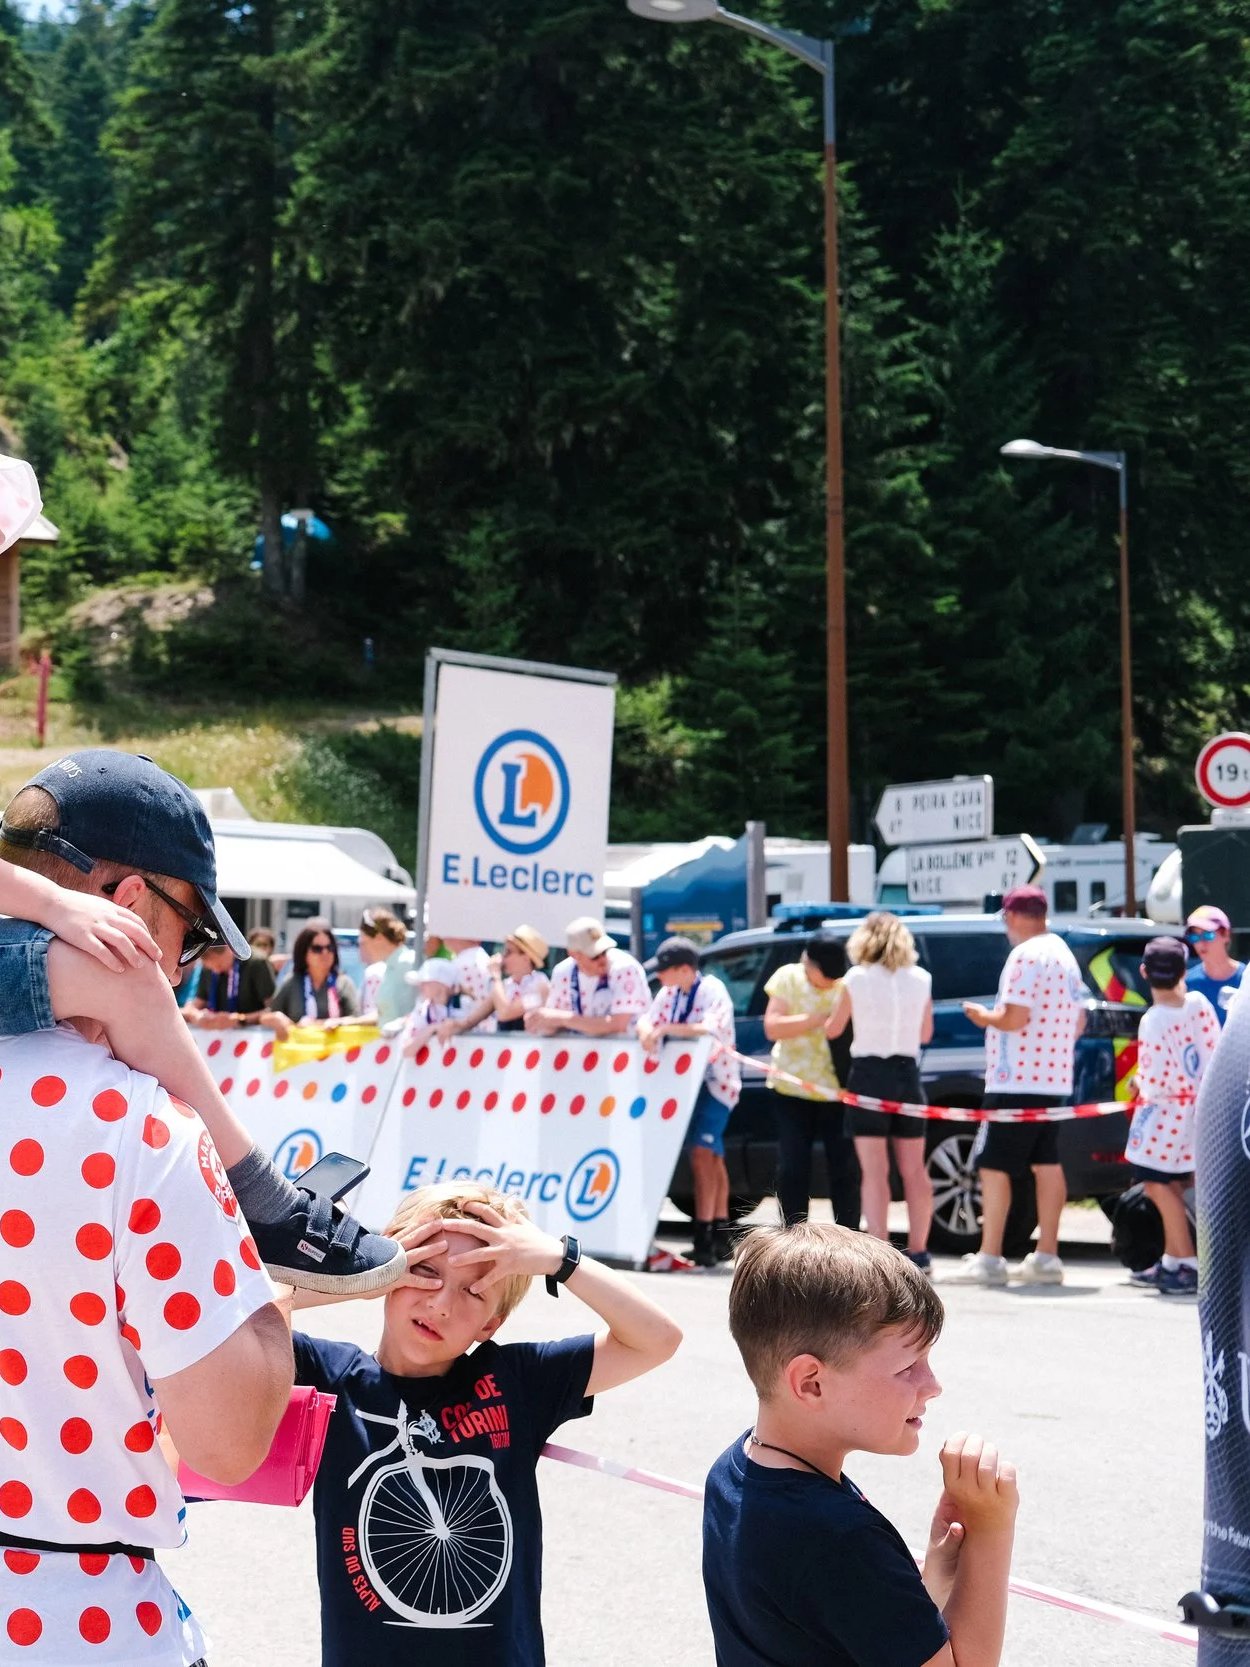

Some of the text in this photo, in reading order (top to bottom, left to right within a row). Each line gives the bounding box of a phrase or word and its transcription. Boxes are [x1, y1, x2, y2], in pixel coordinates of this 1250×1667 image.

[1217, 763, 1239, 781] 19
[499, 762, 542, 827] L
[442, 853, 594, 897] E.Leclerc
[911, 876, 942, 896] NICE
[474, 1373, 502, 1400] DE
[342, 1527, 382, 1612] ALPES DU SUD
